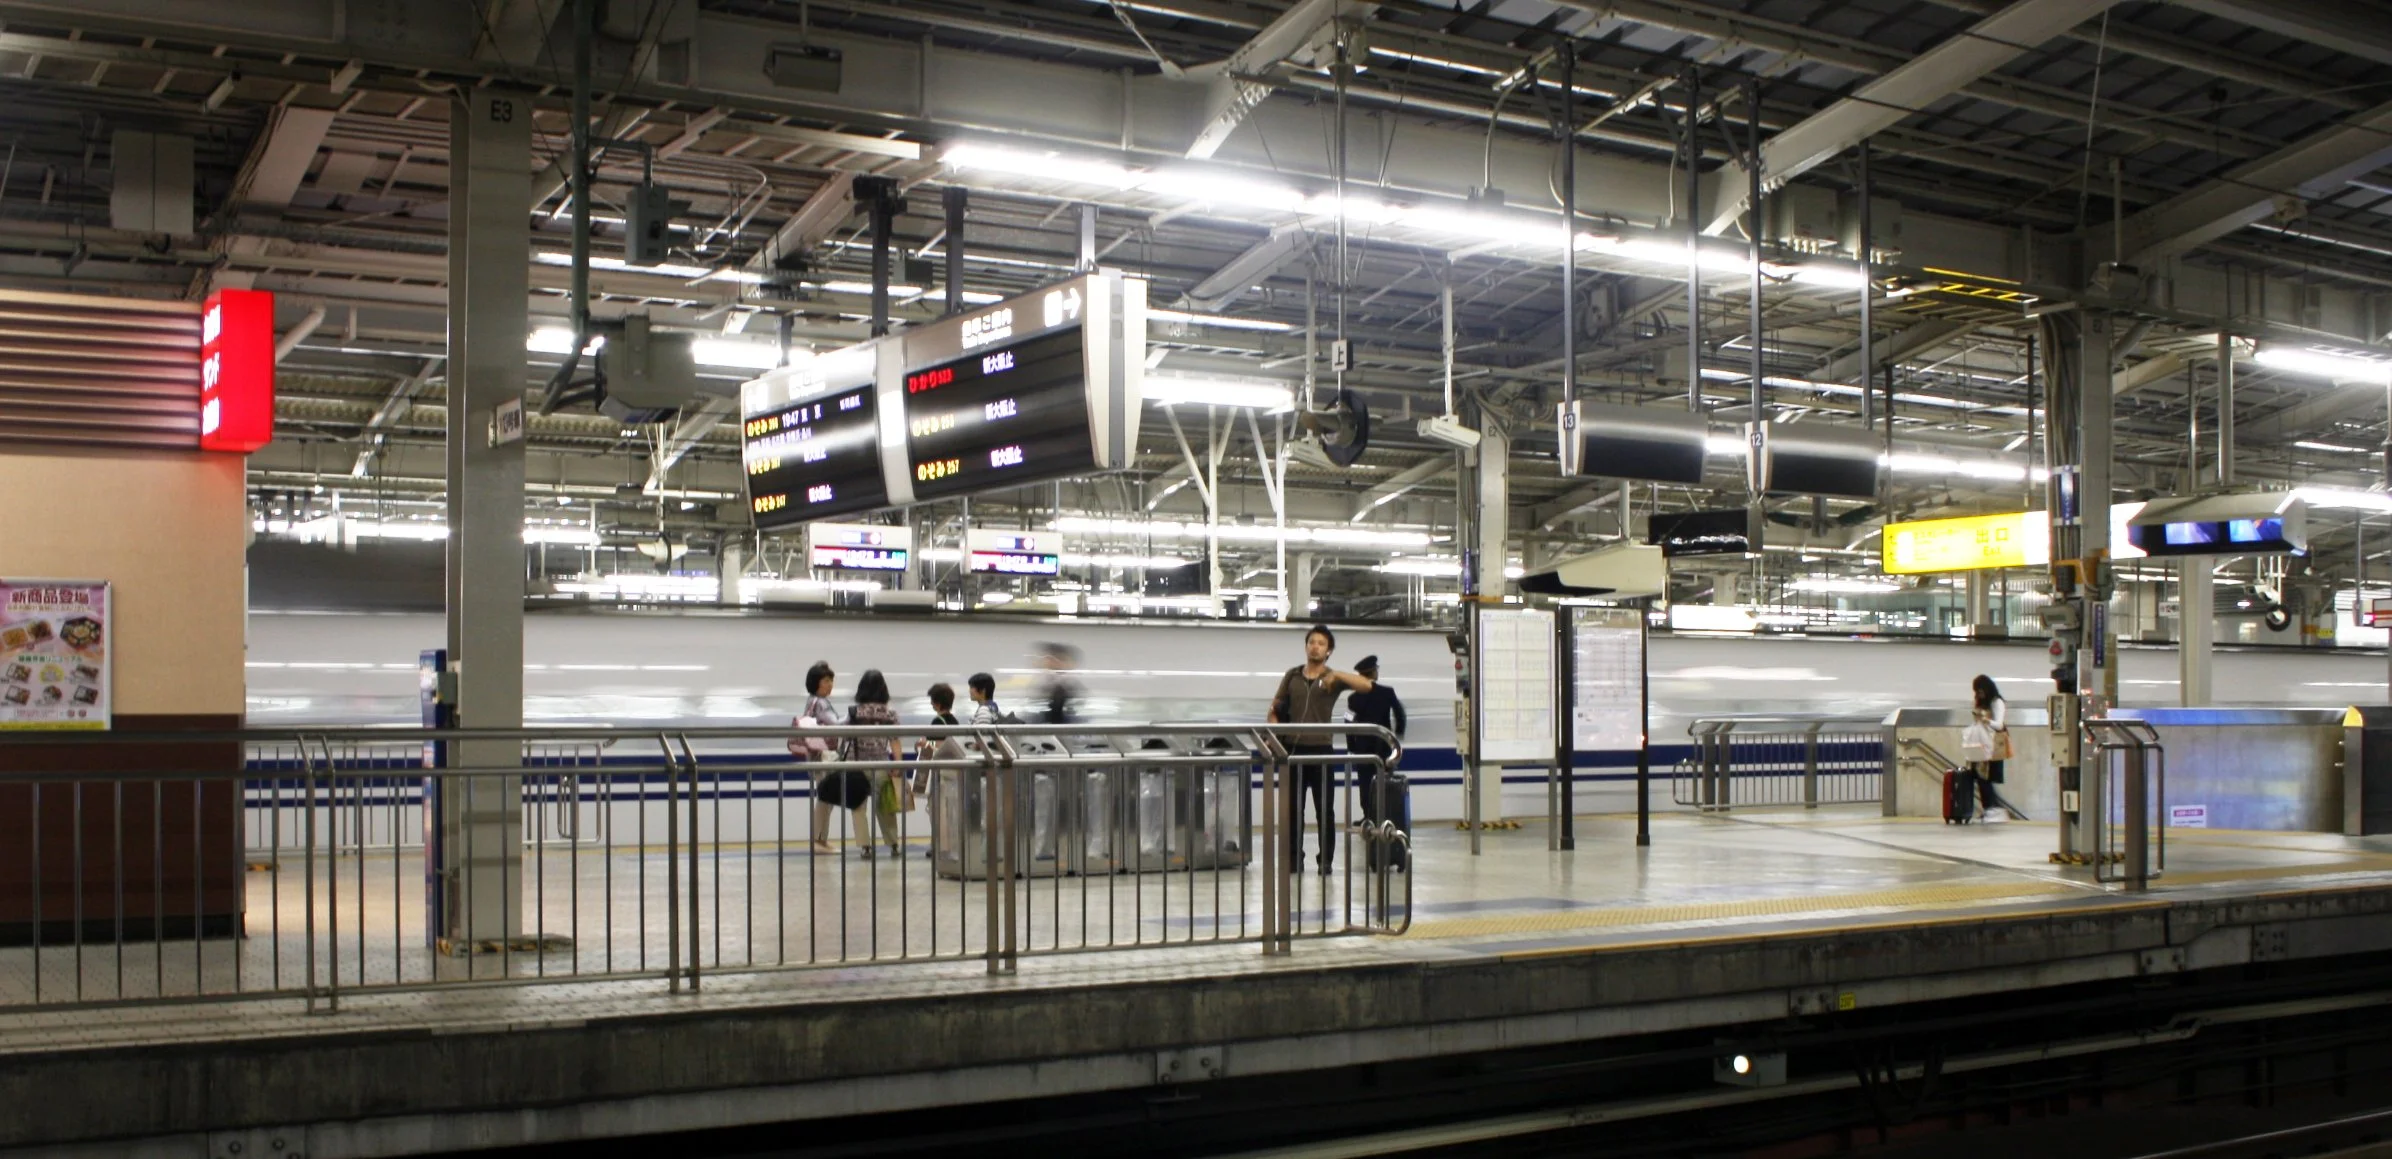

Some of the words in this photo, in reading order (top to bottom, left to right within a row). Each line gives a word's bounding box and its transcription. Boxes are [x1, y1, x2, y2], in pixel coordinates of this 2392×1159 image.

[491, 99, 512, 122] E3
[982, 351, 1014, 375] 新大阪止
[1335, 346, 1345, 366] 上
[908, 371, 937, 393] ひかり
[985, 398, 1017, 420] 新大阪止
[912, 419, 940, 437] のぞみ
[1564, 415, 1574, 428] 13
[1751, 434, 1762, 446] 12
[990, 445, 1023, 468] 新大阪止
[917, 461, 946, 480] のぞみ
[755, 495, 776, 513] のぞみ
[1976, 528, 2009, 544] 出口
[11, 587, 89, 604] 新商品登場
